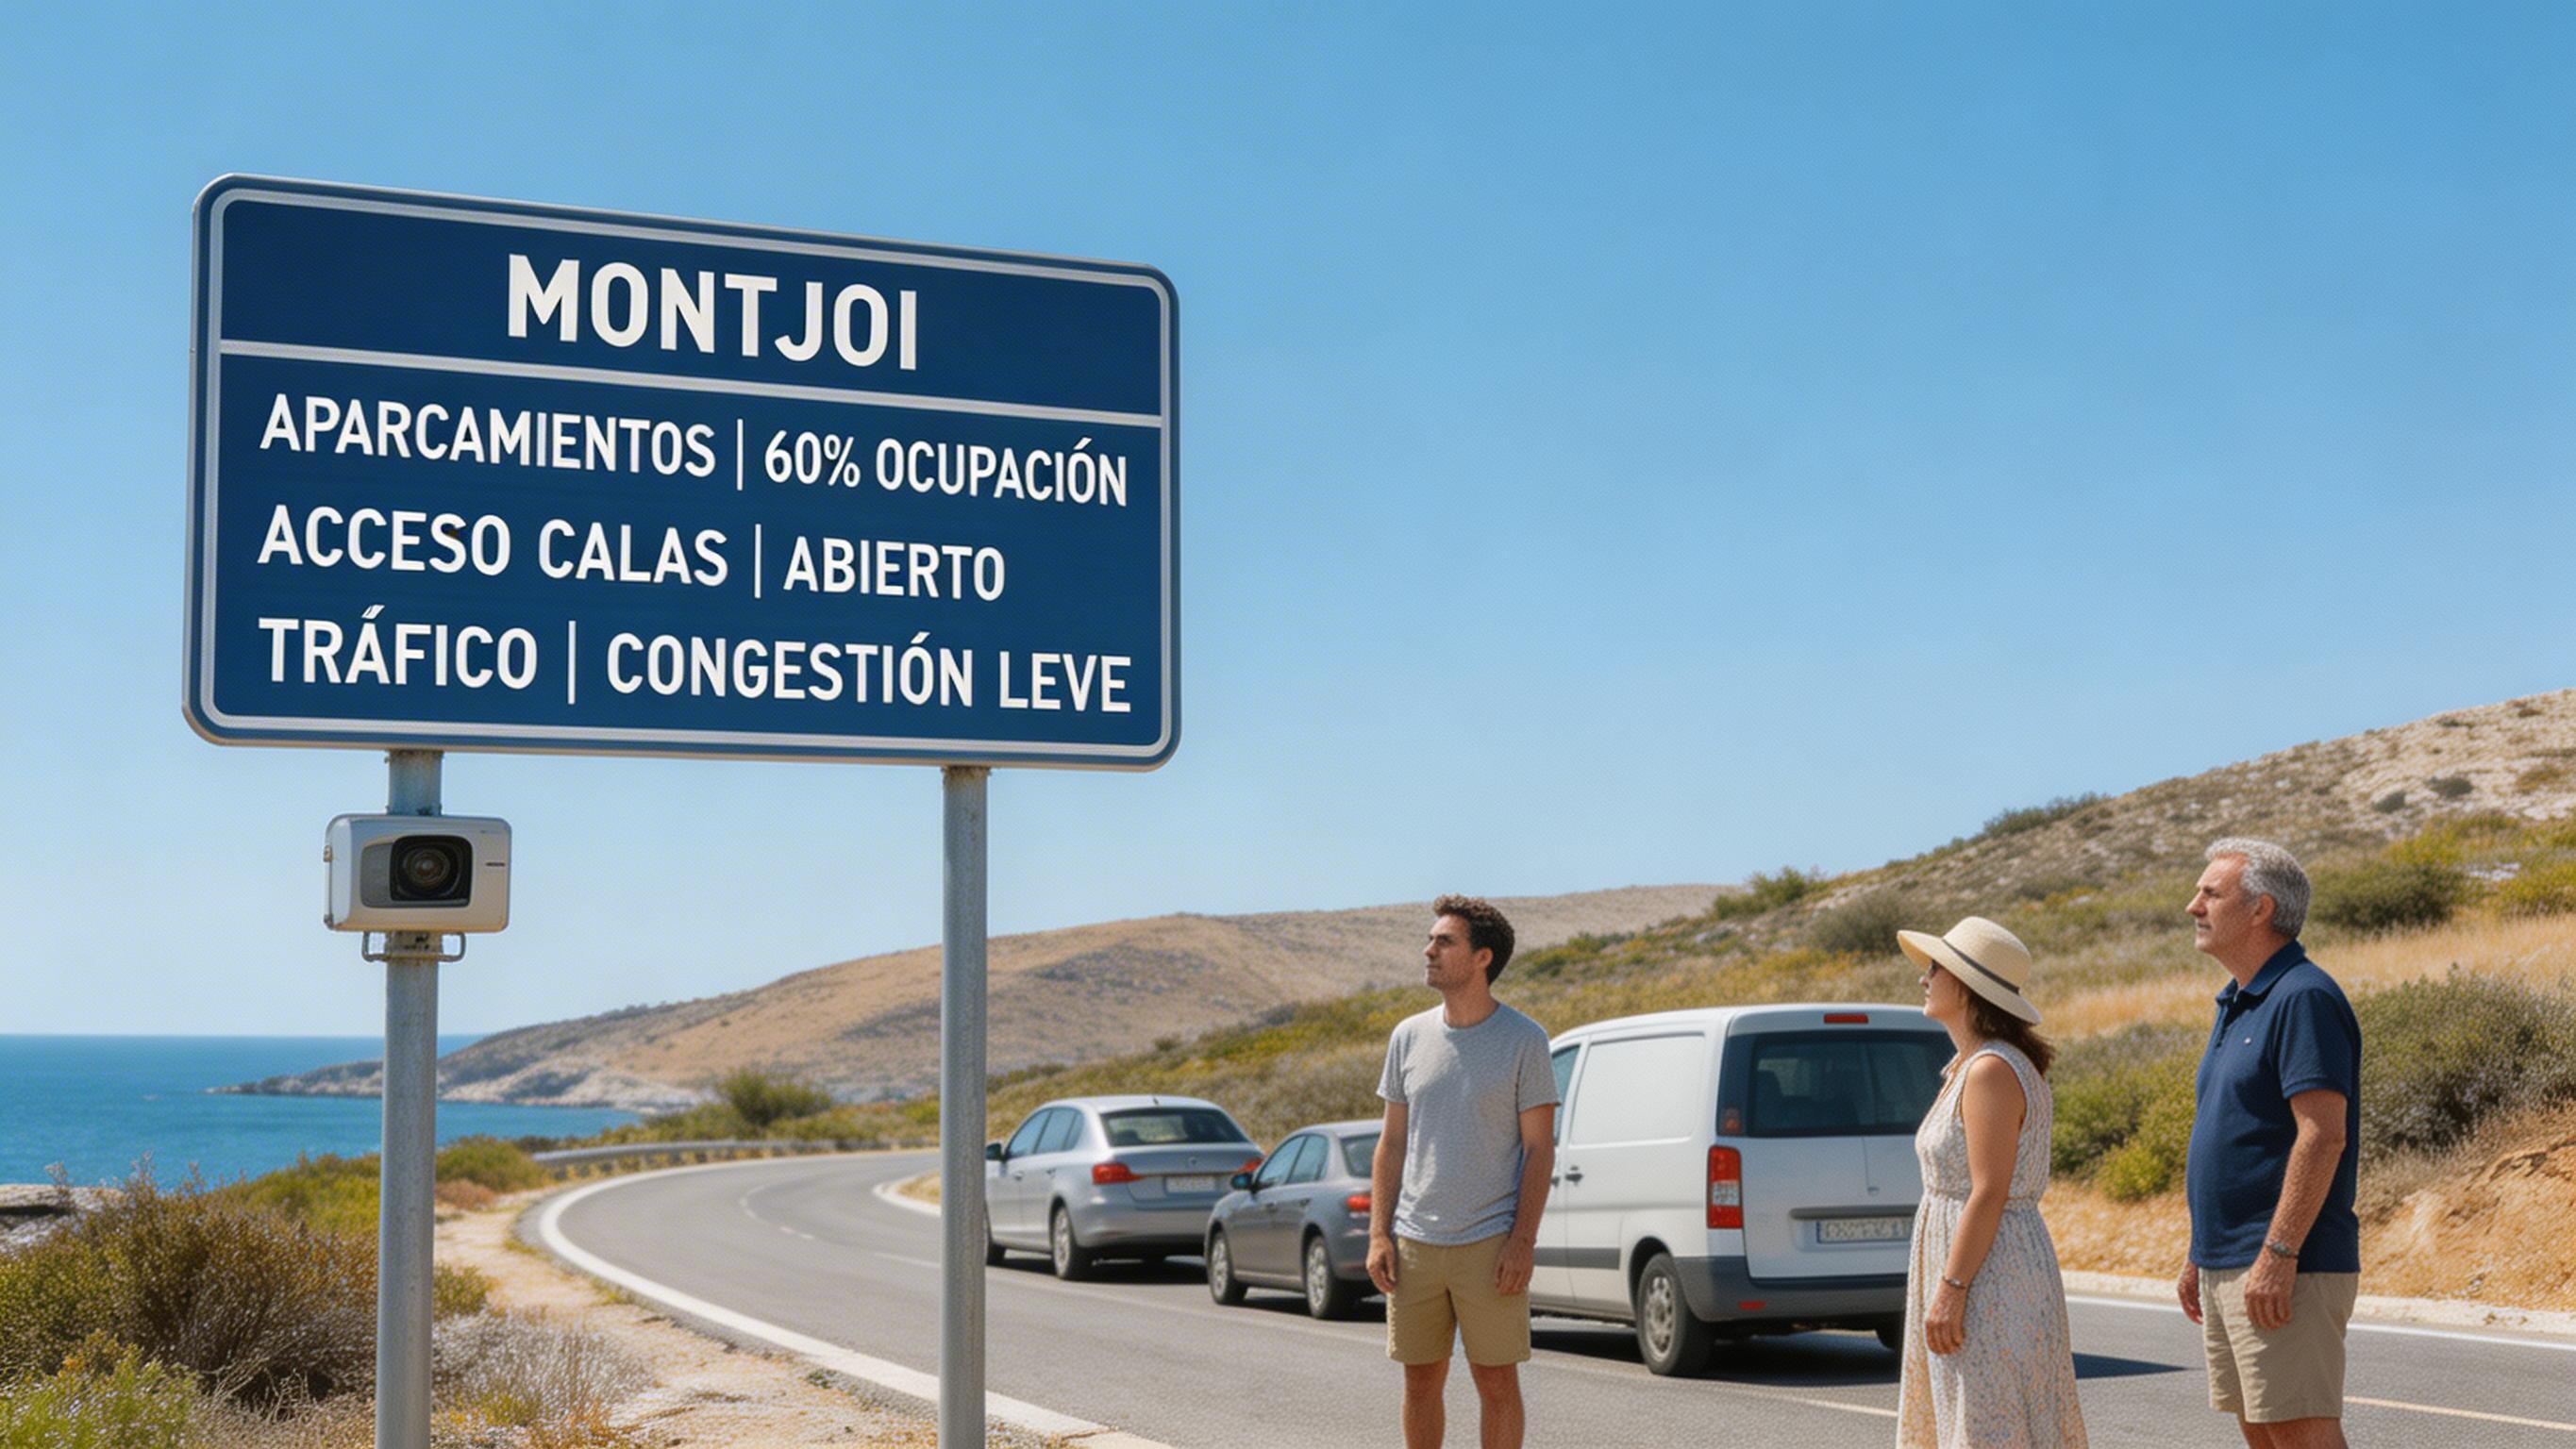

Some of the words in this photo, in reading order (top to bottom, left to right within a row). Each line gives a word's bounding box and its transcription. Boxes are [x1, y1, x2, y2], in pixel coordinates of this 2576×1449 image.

[508, 254, 916, 371] MONTJOI
[259, 393, 715, 477] APARCAMIENTOS
[764, 430, 861, 488] 60%
[876, 437, 1127, 507] OCUPACIÓN
[257, 504, 510, 576] ACCESO
[539, 519, 728, 587] CALAS
[783, 536, 1005, 601] ABIERTO
[259, 604, 537, 690] TRÁFICO
[607, 631, 973, 707] CONGESTIÓN
[999, 651, 1131, 712] LEVE
